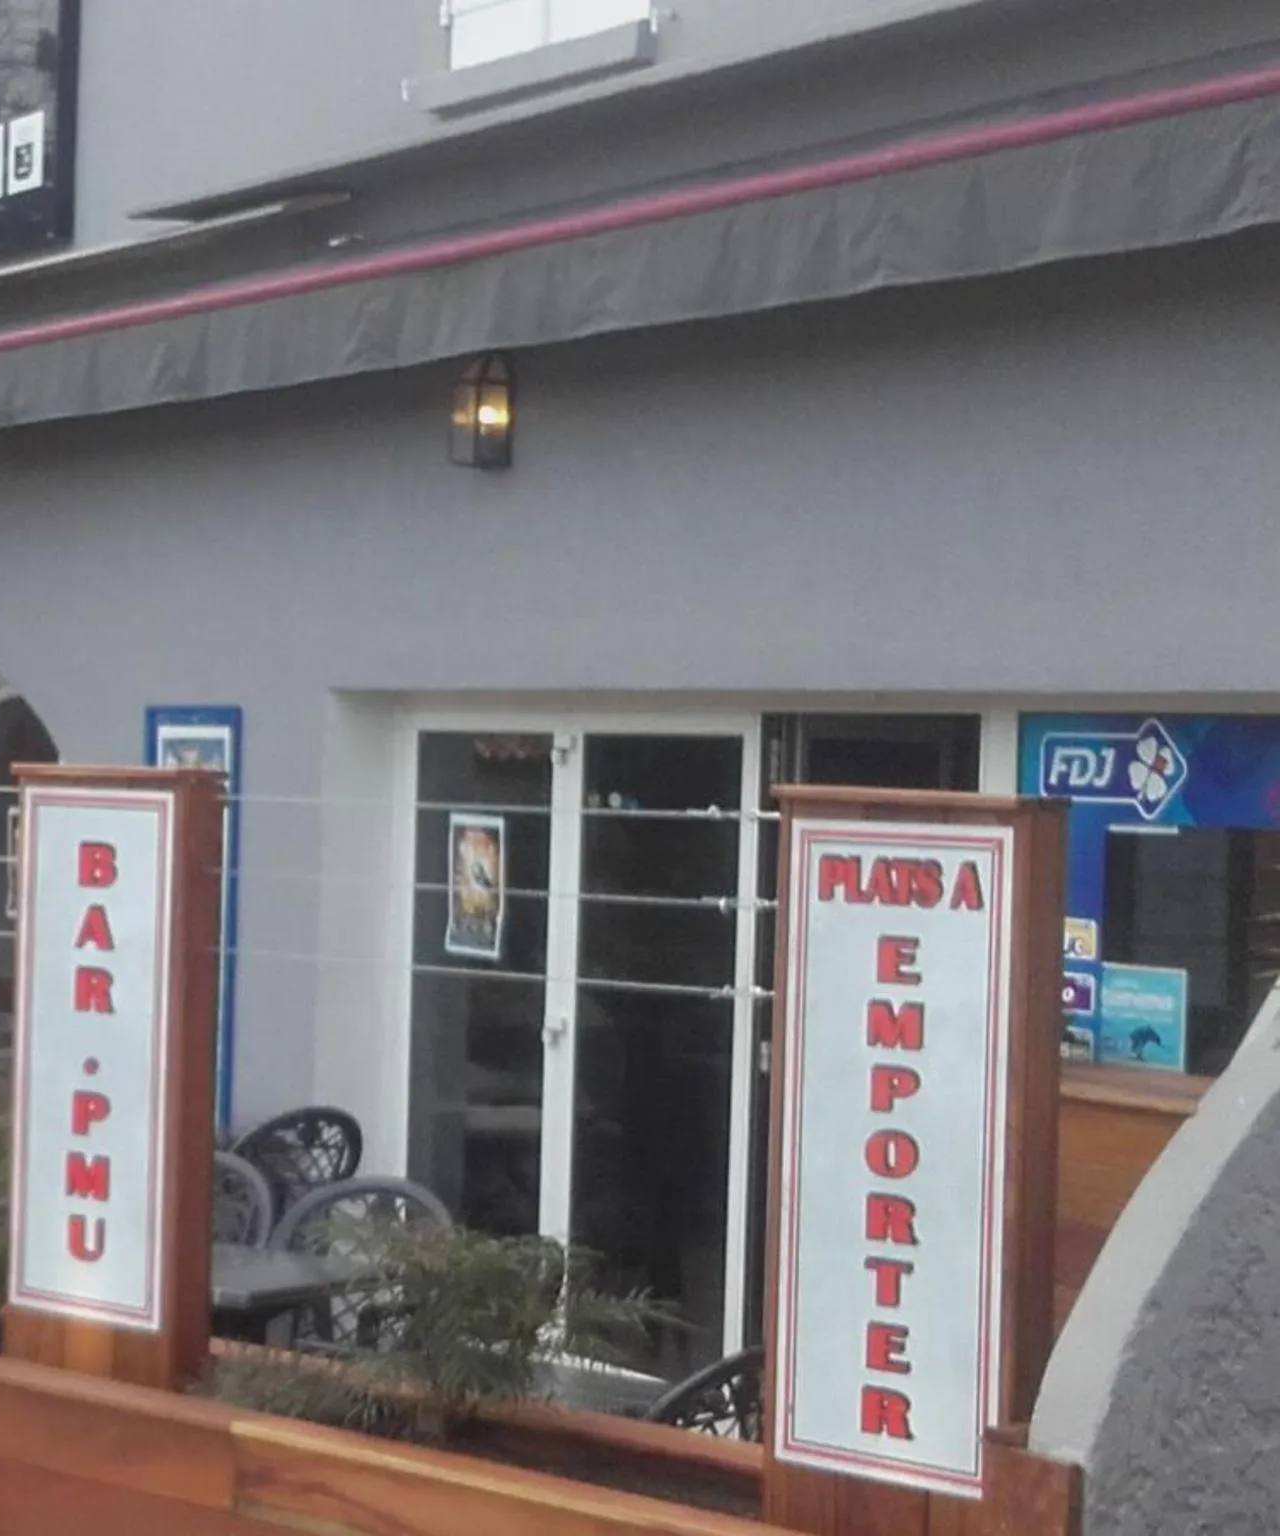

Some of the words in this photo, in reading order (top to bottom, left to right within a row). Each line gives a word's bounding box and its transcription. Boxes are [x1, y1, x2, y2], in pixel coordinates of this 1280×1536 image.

[1048, 746, 1117, 788] FDJ
[73, 840, 119, 1017] BAR
[818, 853, 945, 909] PLATS
[64, 1089, 112, 1263] PMU
[859, 934, 925, 1441] EMPORTER
